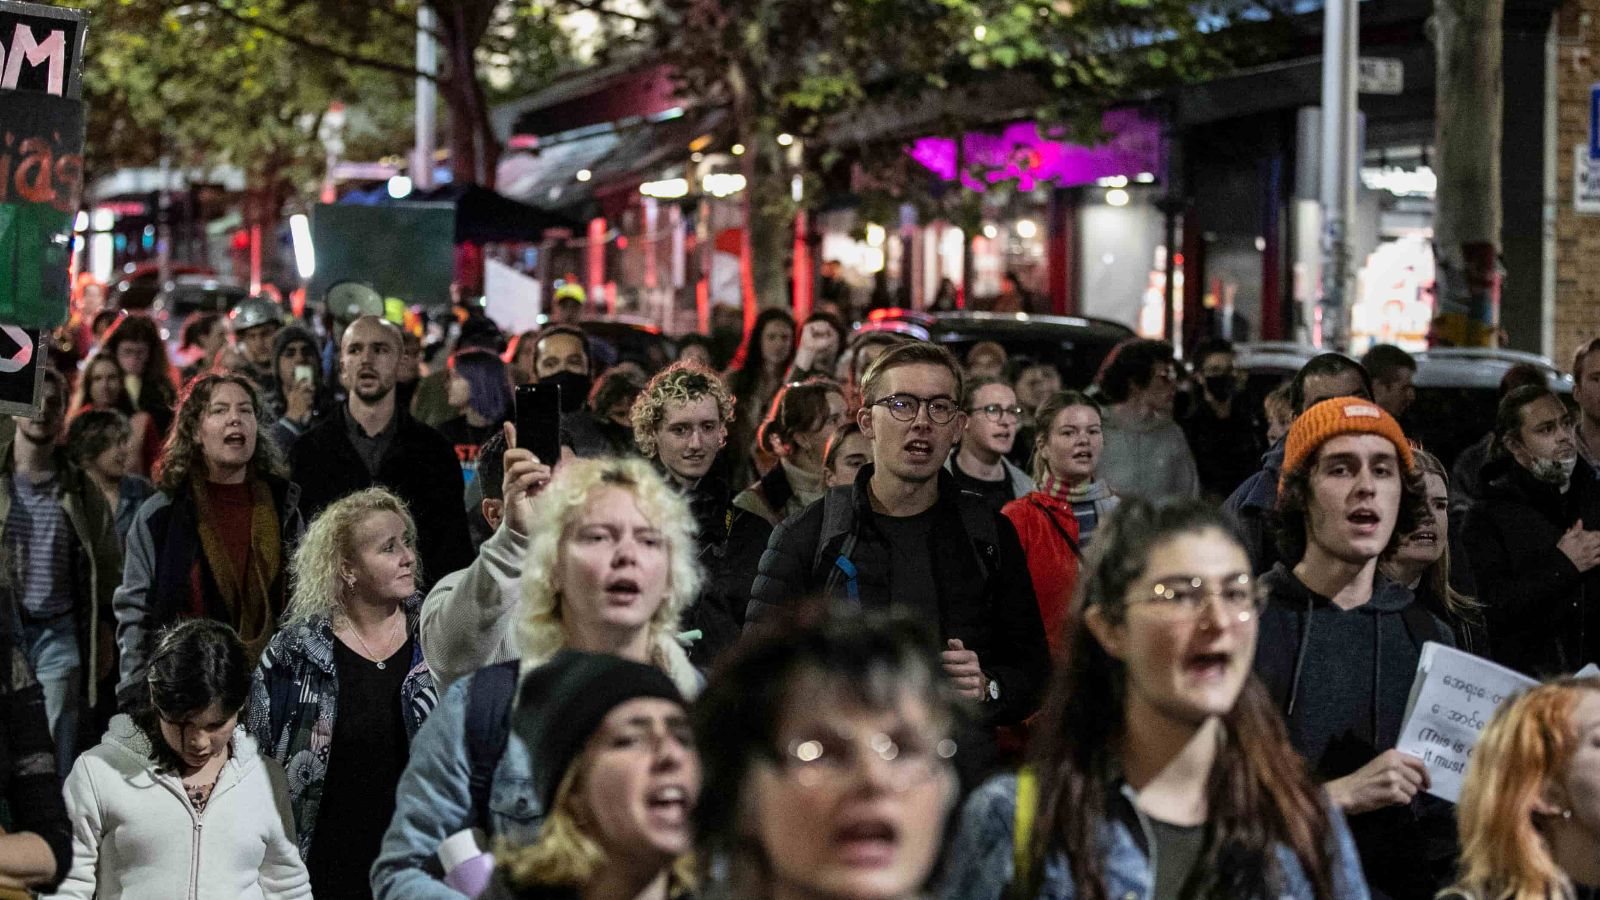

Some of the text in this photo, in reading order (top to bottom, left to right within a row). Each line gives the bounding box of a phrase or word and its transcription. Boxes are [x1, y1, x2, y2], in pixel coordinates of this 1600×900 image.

[1418, 727, 1450, 748] (This
[1452, 739, 1465, 754] is
[1433, 755, 1465, 774] must
